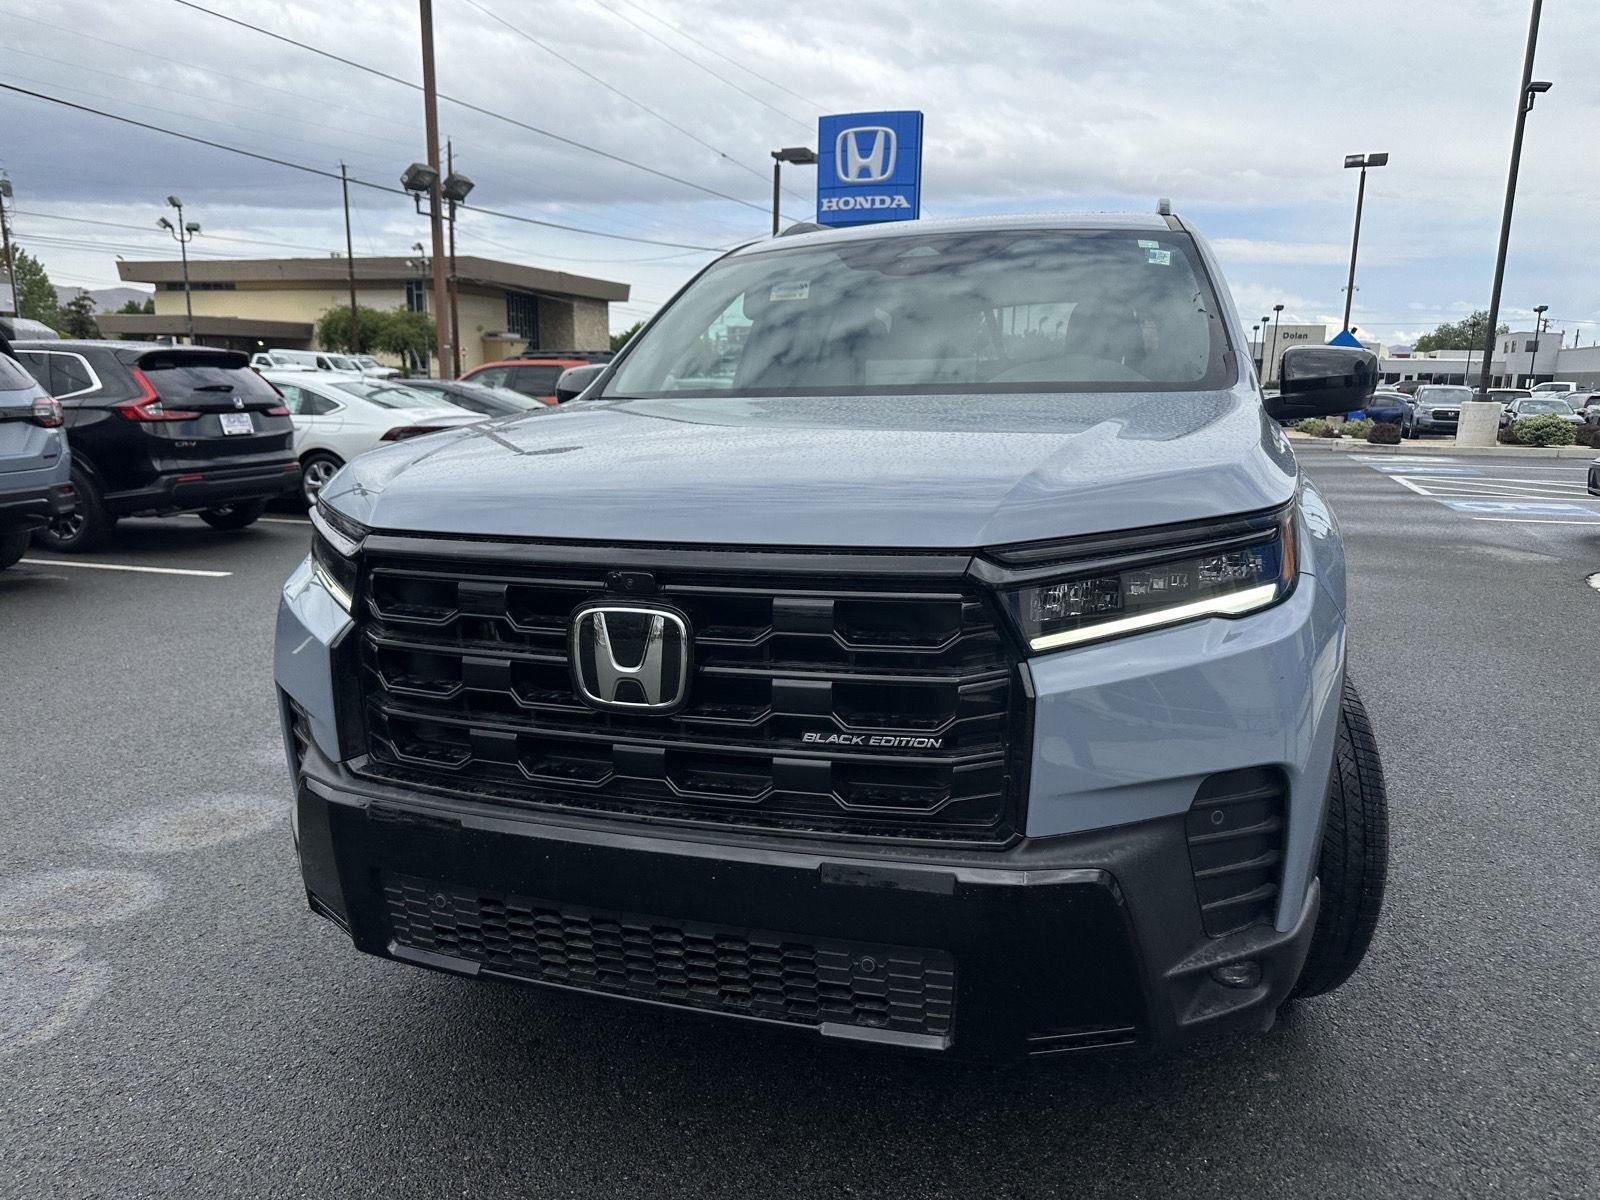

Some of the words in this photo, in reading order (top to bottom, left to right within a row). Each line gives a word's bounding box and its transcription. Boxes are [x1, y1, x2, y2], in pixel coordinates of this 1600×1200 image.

[821, 195, 911, 211] HONDA
[802, 732, 866, 745] BLACK
[869, 735, 943, 748] EDITION
